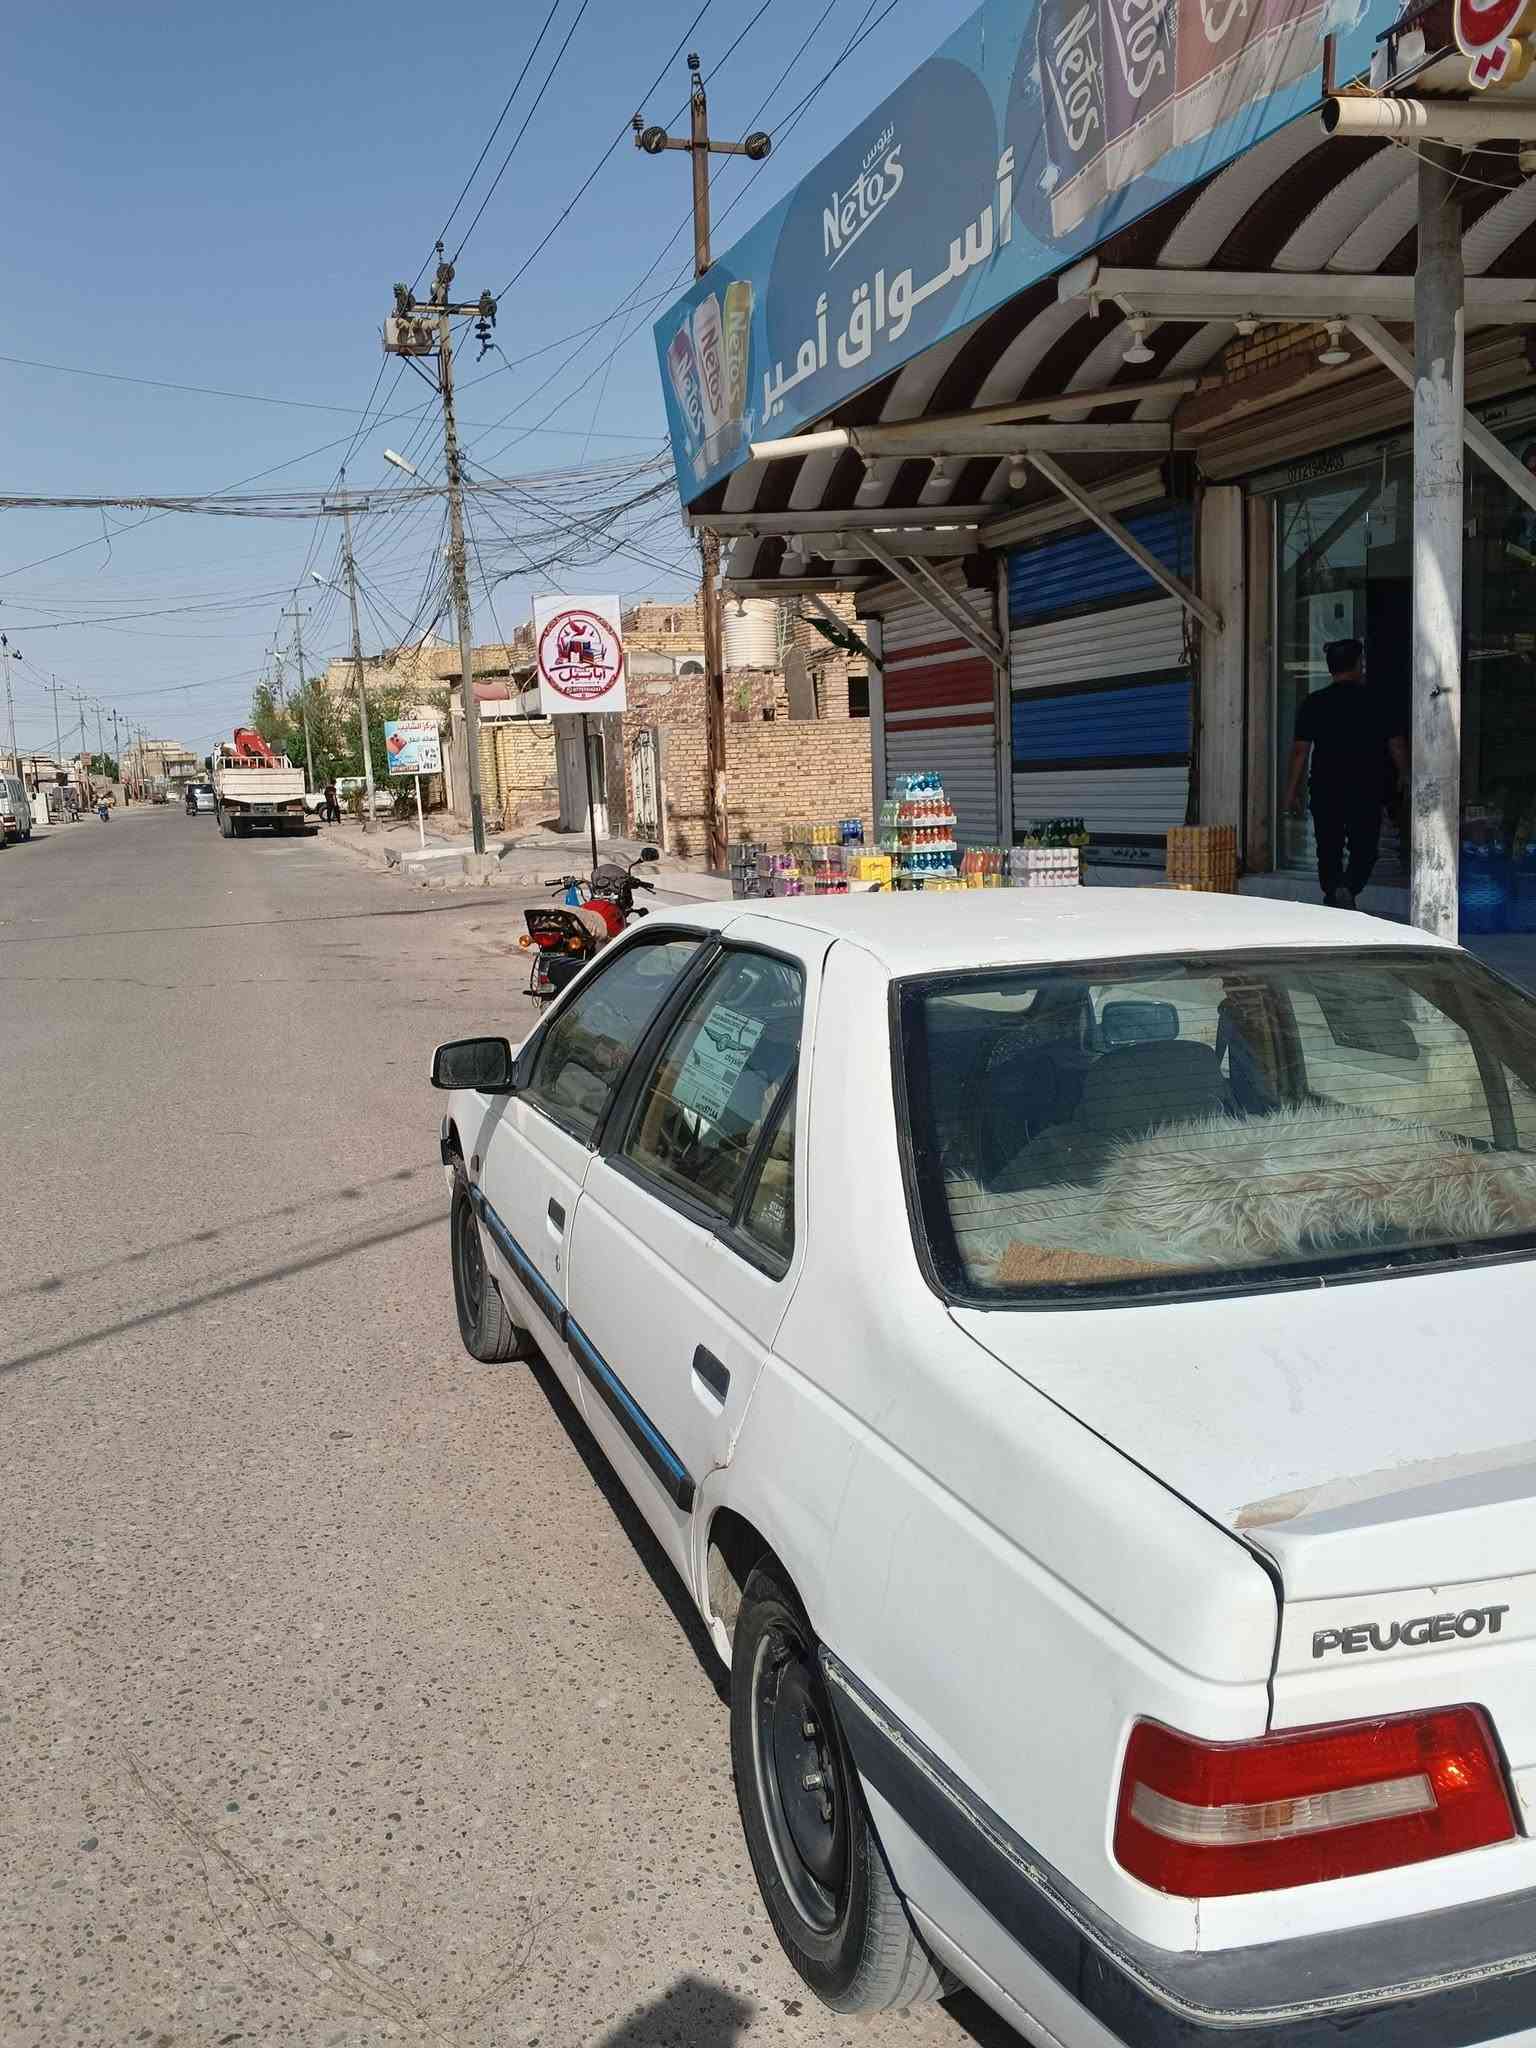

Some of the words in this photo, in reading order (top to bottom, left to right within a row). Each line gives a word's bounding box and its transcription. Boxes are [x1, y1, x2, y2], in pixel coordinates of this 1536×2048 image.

[1054, 3, 1102, 151] Netos
[1122, 0, 1168, 98] tos
[862, 121, 896, 169] نيتوس
[823, 143, 905, 260] Netos
[837, 144, 1015, 369] أسواق
[678, 351, 705, 434] Netos
[701, 326, 723, 416] Netos
[728, 312, 747, 403] Netos
[762, 291, 829, 425] أمير
[1312, 1604, 1510, 1659] PEUGEOT
